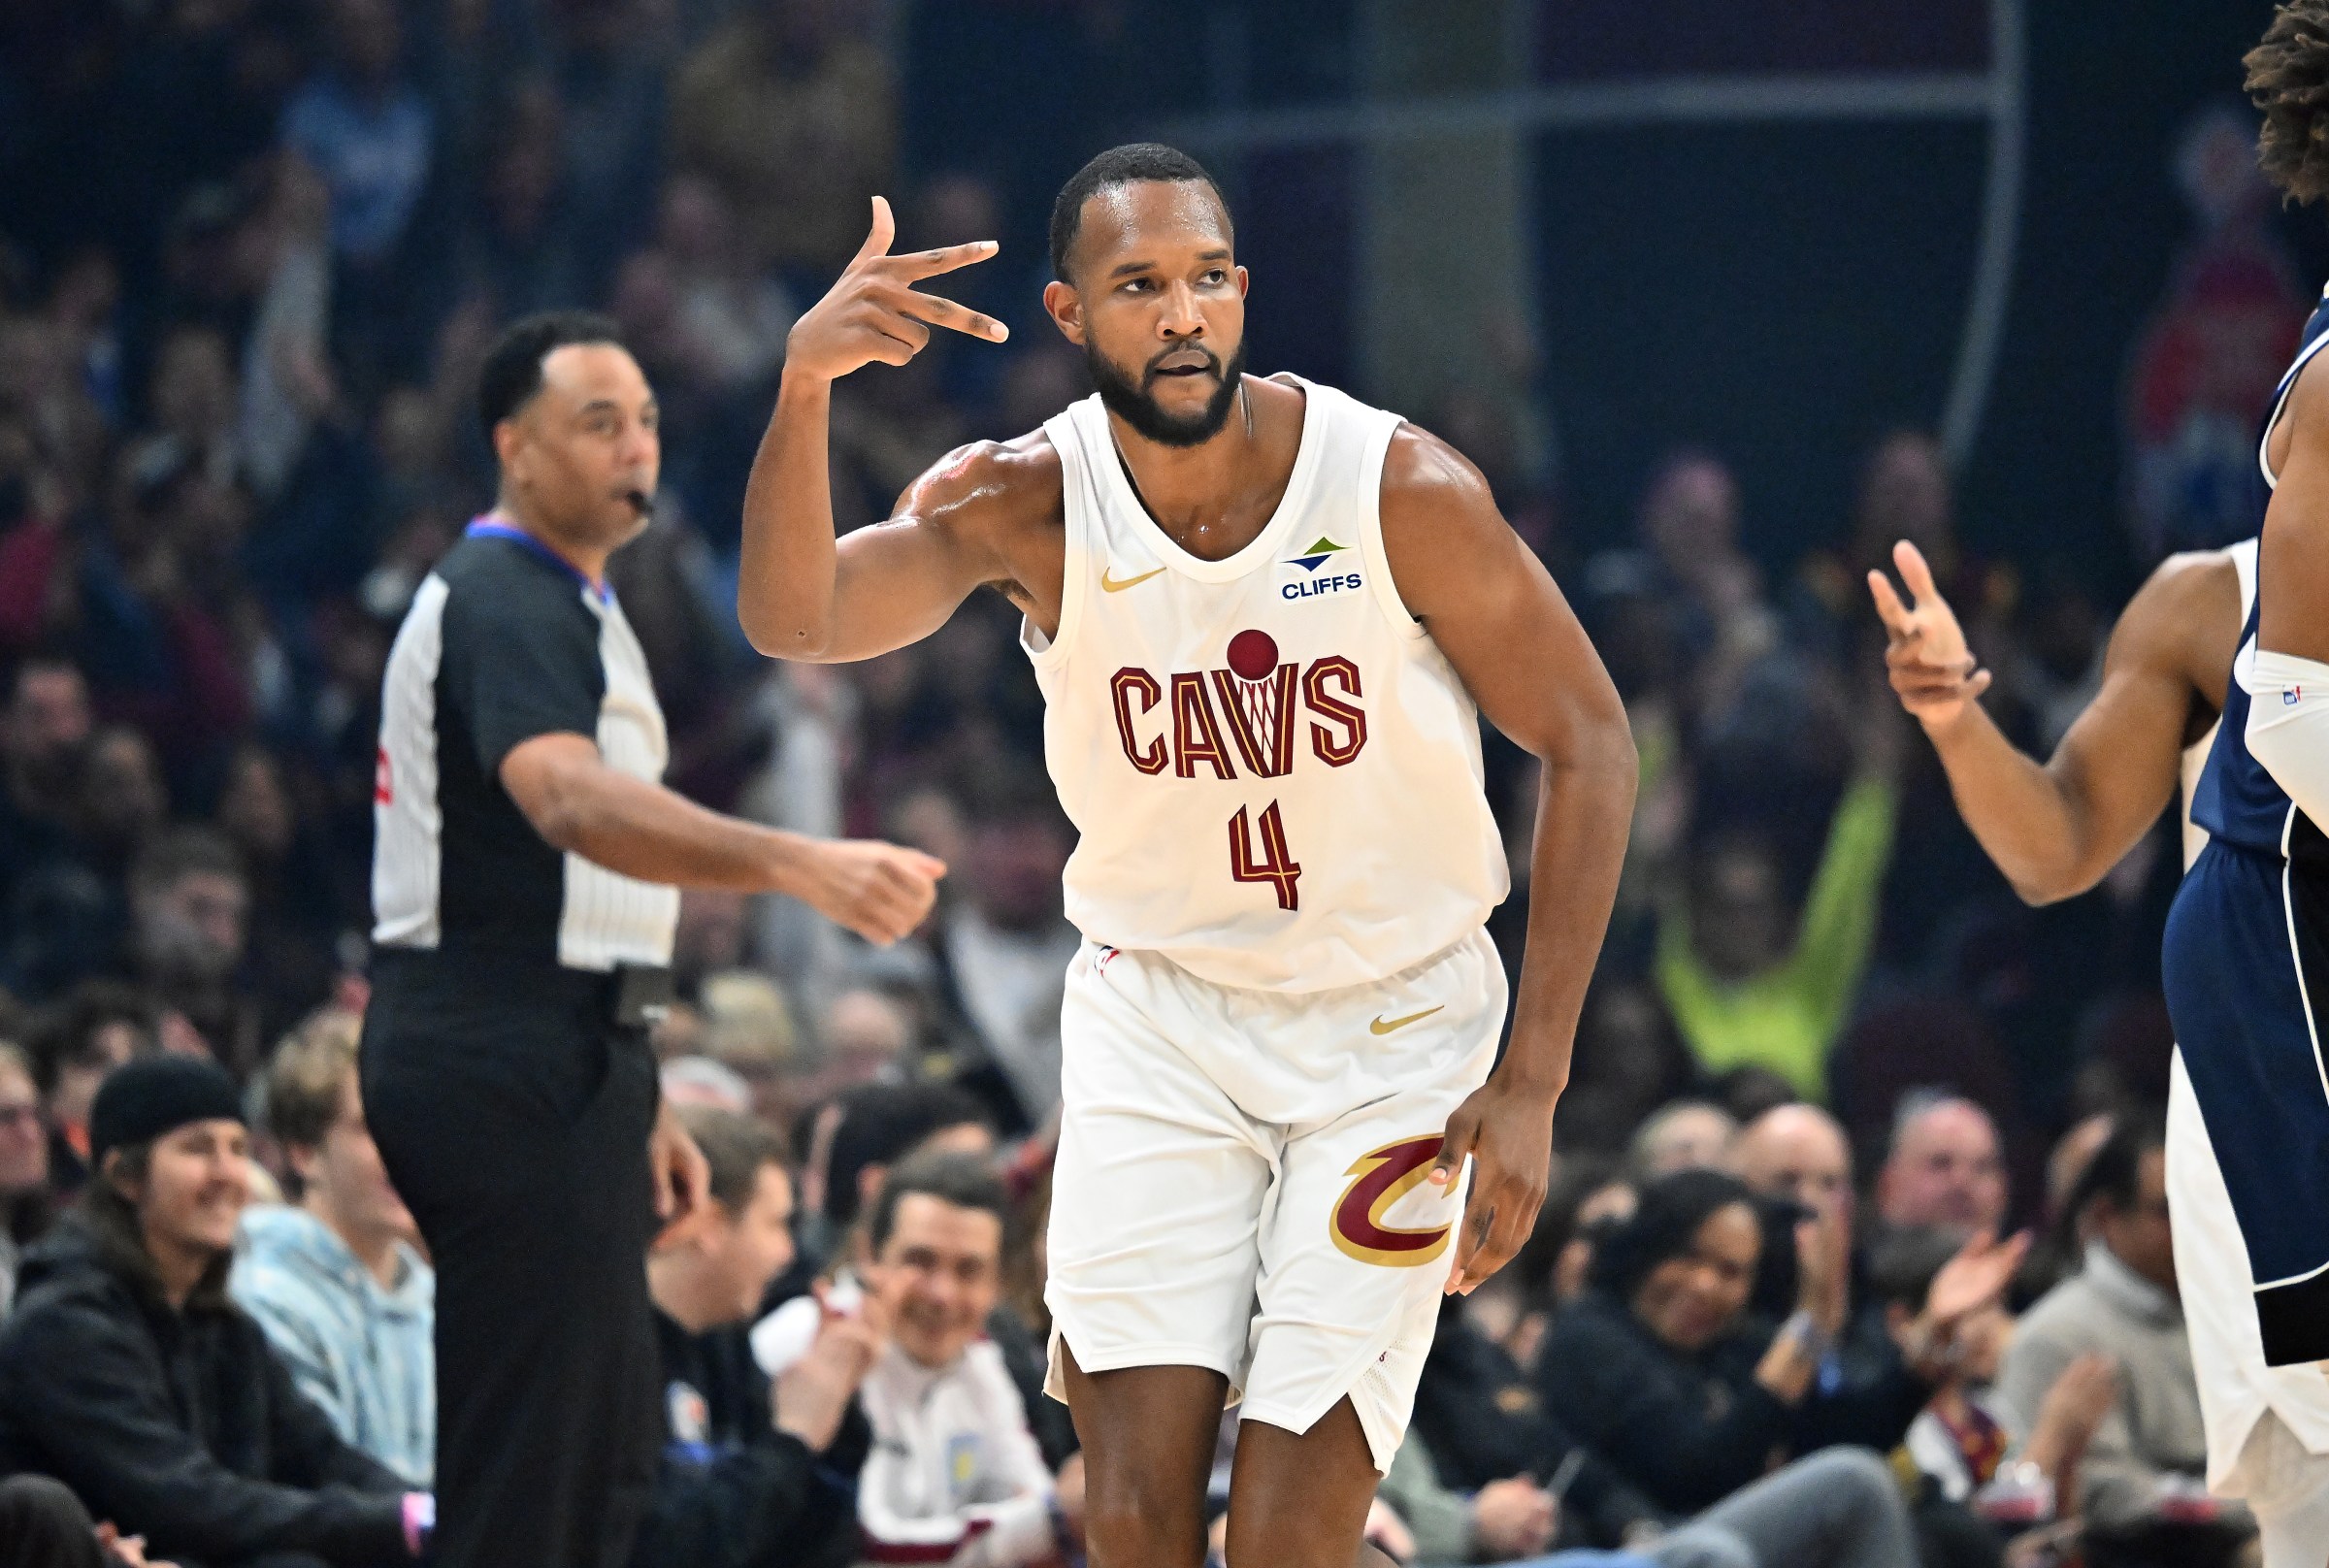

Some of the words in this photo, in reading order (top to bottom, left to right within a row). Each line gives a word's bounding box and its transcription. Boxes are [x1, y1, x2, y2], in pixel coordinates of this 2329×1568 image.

[1281, 573, 1362, 601] CLIFFS
[1110, 653, 1368, 780] CAVS
[1228, 798, 1302, 912] 4
[1329, 1131, 1460, 1268] C
